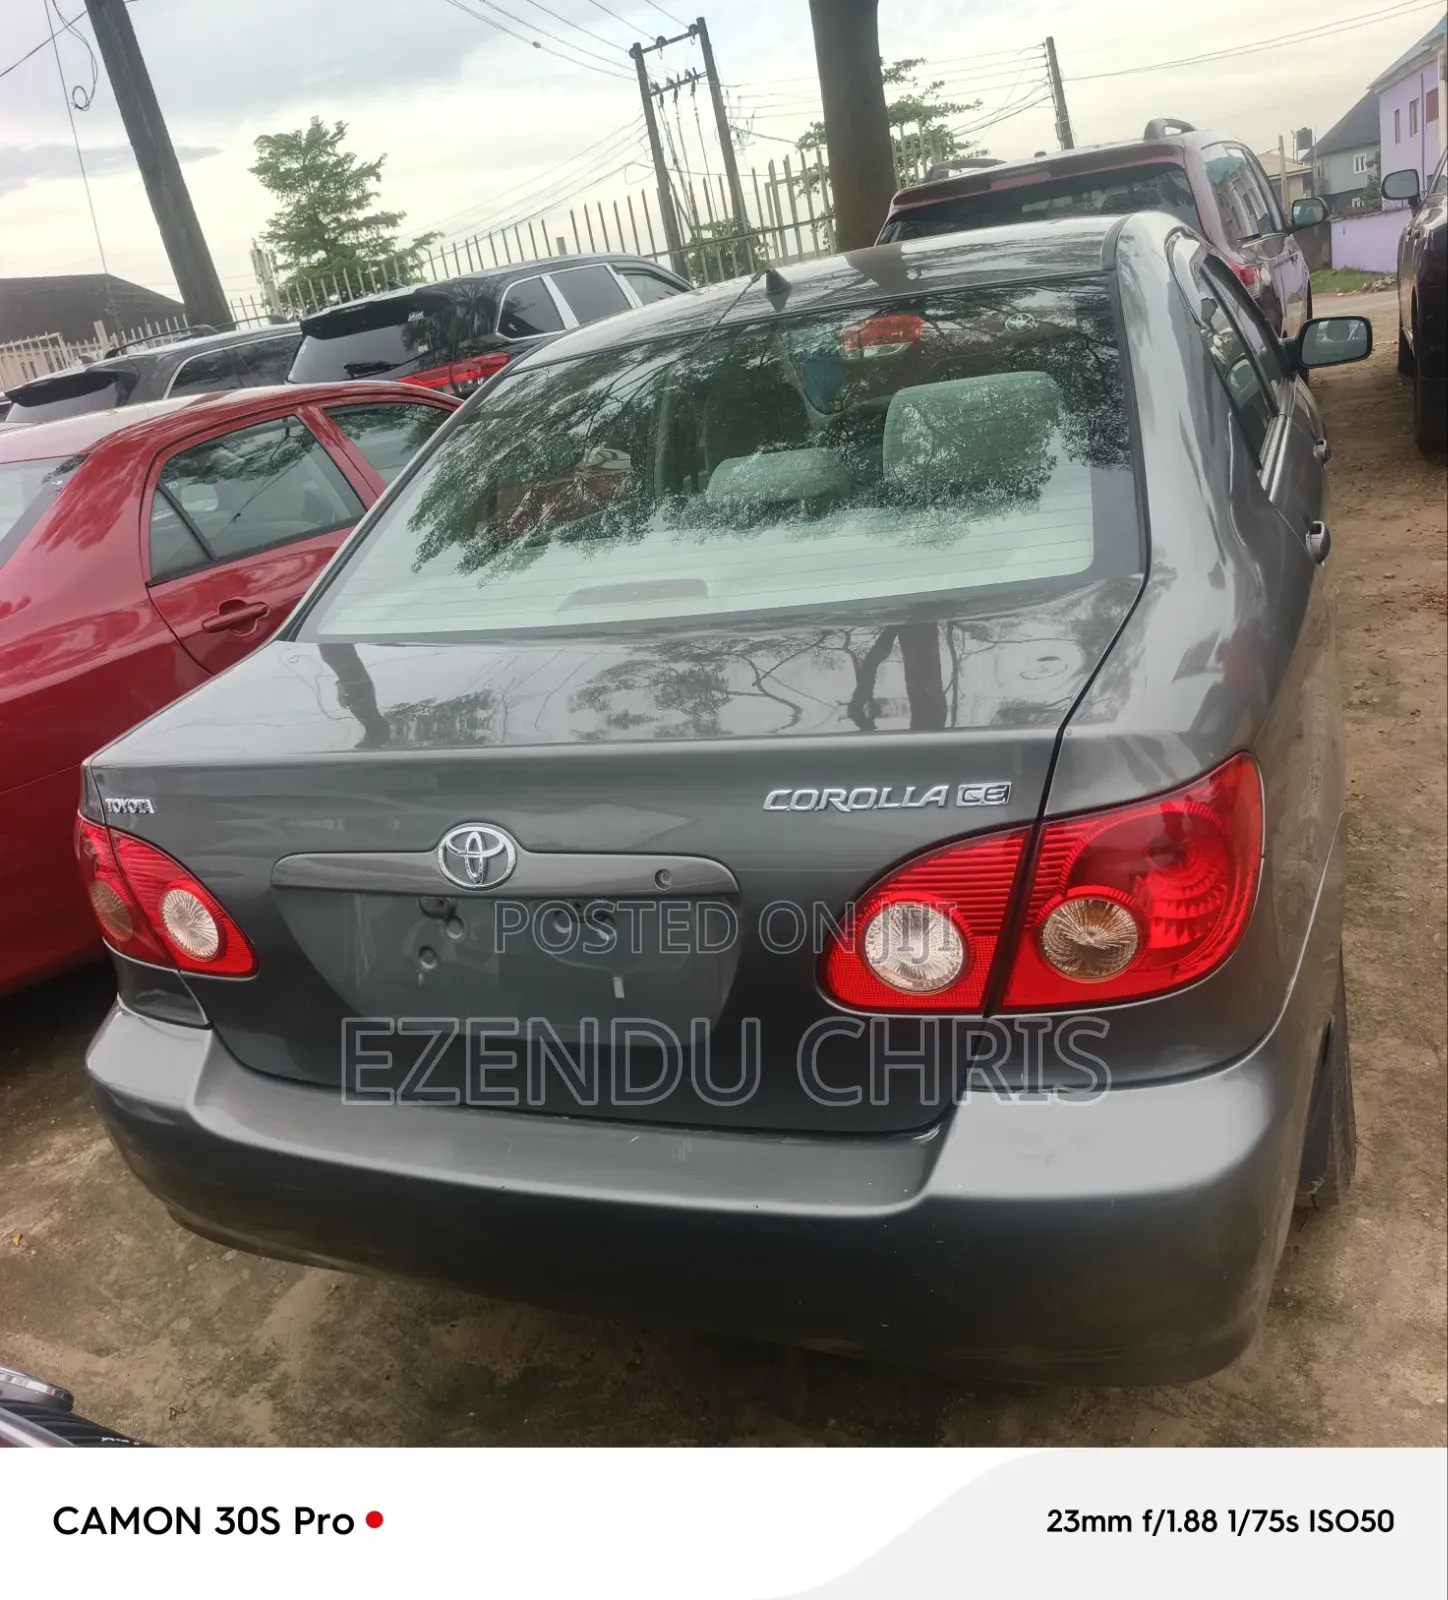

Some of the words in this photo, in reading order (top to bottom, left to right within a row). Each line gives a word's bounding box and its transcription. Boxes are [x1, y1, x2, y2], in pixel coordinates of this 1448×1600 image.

[104, 798, 156, 814] TOYOTA
[763, 785, 949, 812] COROLLA
[956, 782, 1012, 807] CE
